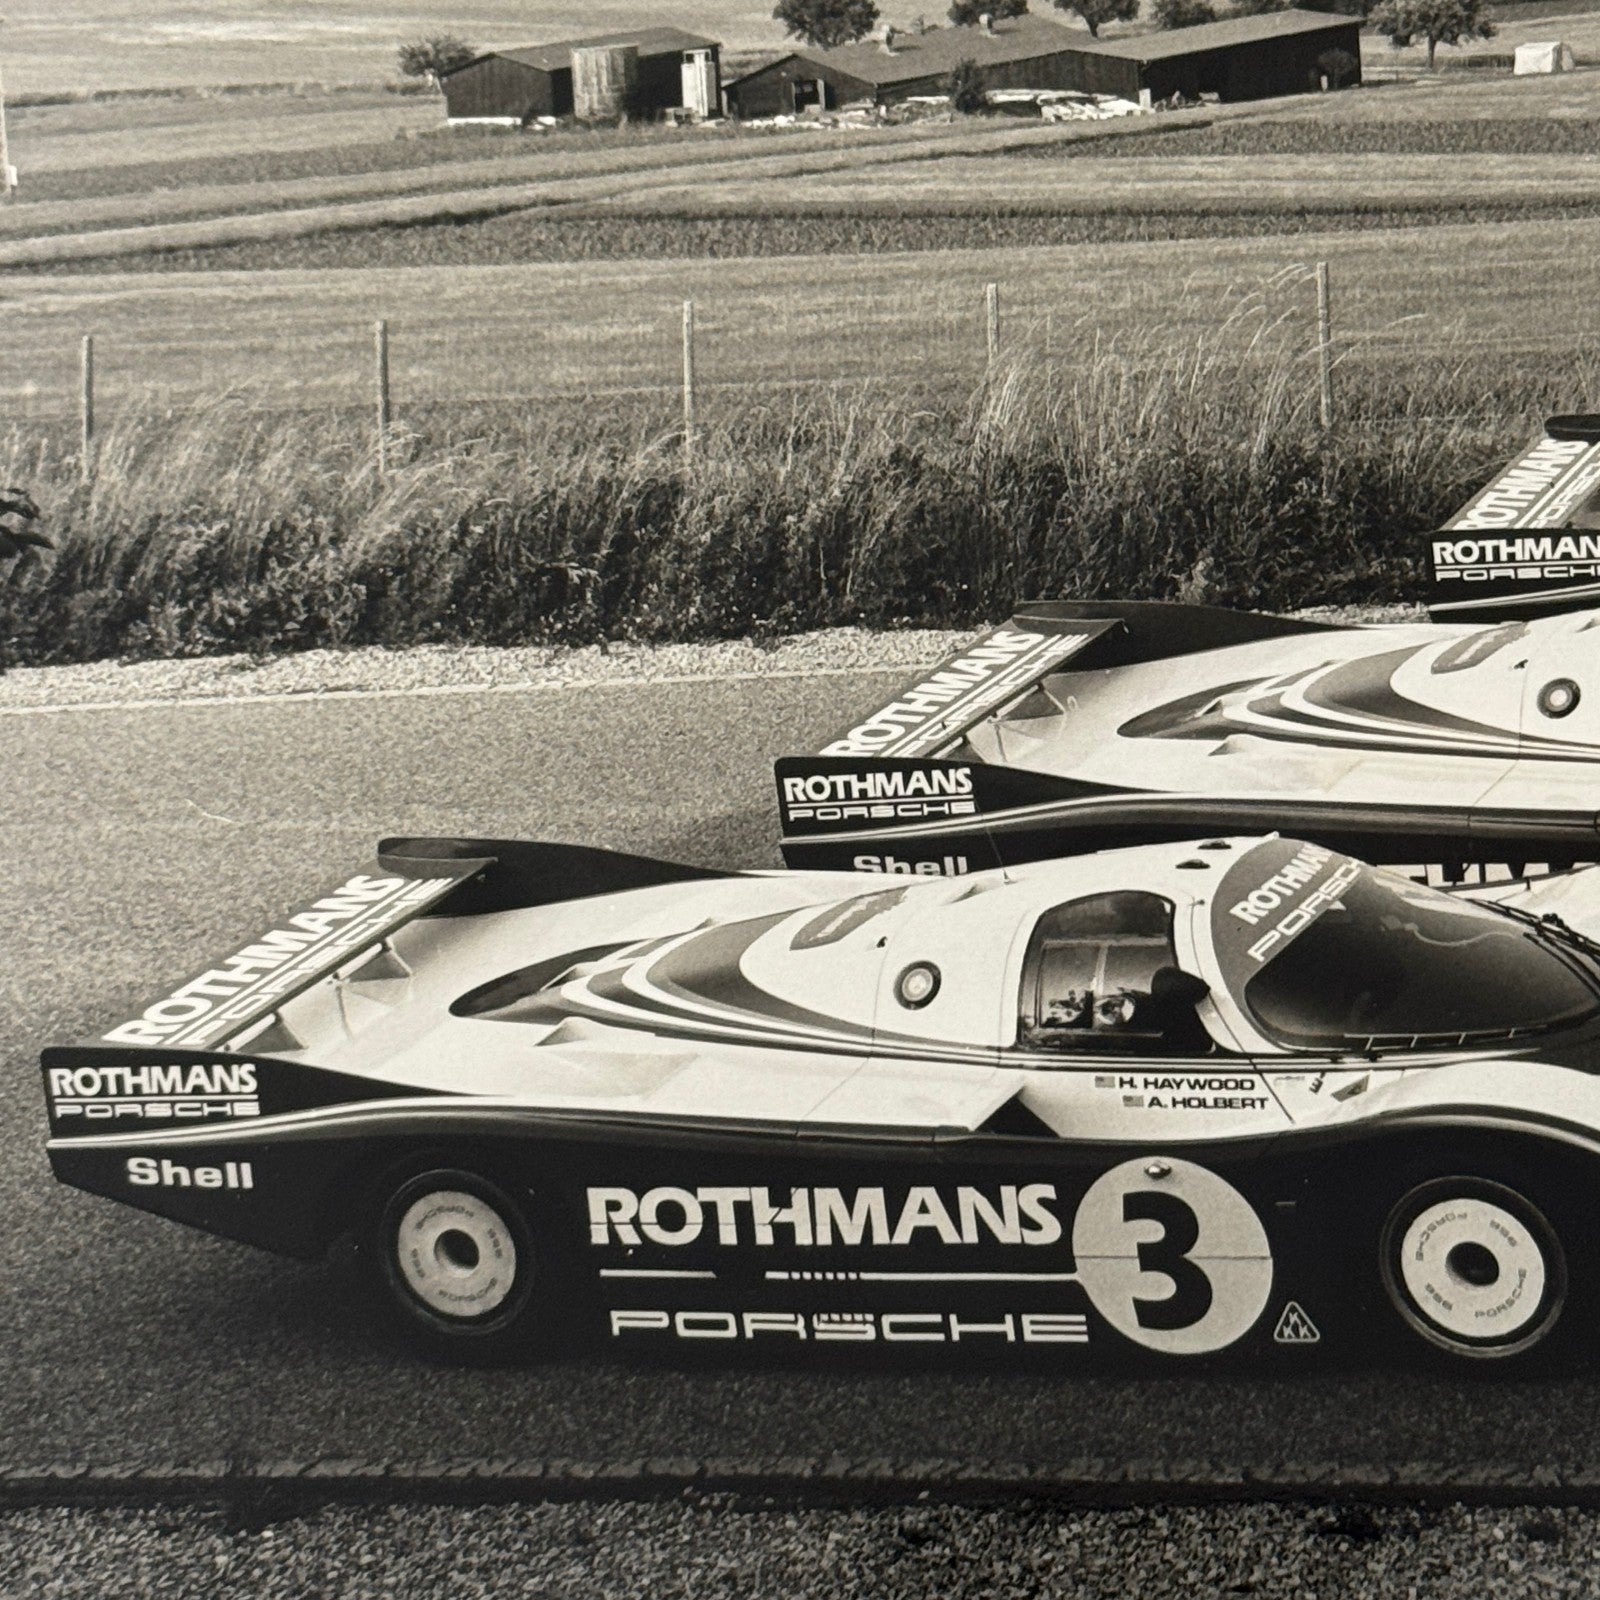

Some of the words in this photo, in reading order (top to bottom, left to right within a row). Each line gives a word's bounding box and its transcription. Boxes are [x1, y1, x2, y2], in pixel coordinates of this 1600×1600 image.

[1436, 564, 1600, 582] PORSCH
[819, 631, 1045, 756] ROTHMANS
[783, 767, 973, 803] ROTHMANS
[788, 801, 976, 822] PORSCHE
[102, 876, 405, 1045] ROTHMANS
[179, 878, 453, 1045] PORSCHE
[49, 1063, 258, 1097] ROTHMANS
[1119, 1077, 1137, 1089] H.
[1144, 1077, 1255, 1090] HAYWOOD
[55, 1101, 260, 1119] PORSCHE
[1148, 1096, 1168, 1109] A.
[1172, 1096, 1269, 1109] HOLBERT
[127, 1156, 254, 1189] Shell
[586, 1185, 1062, 1246] ROTHMANS
[1123, 1190, 1213, 1331] 3
[610, 1310, 1089, 1345] PORSCHE
